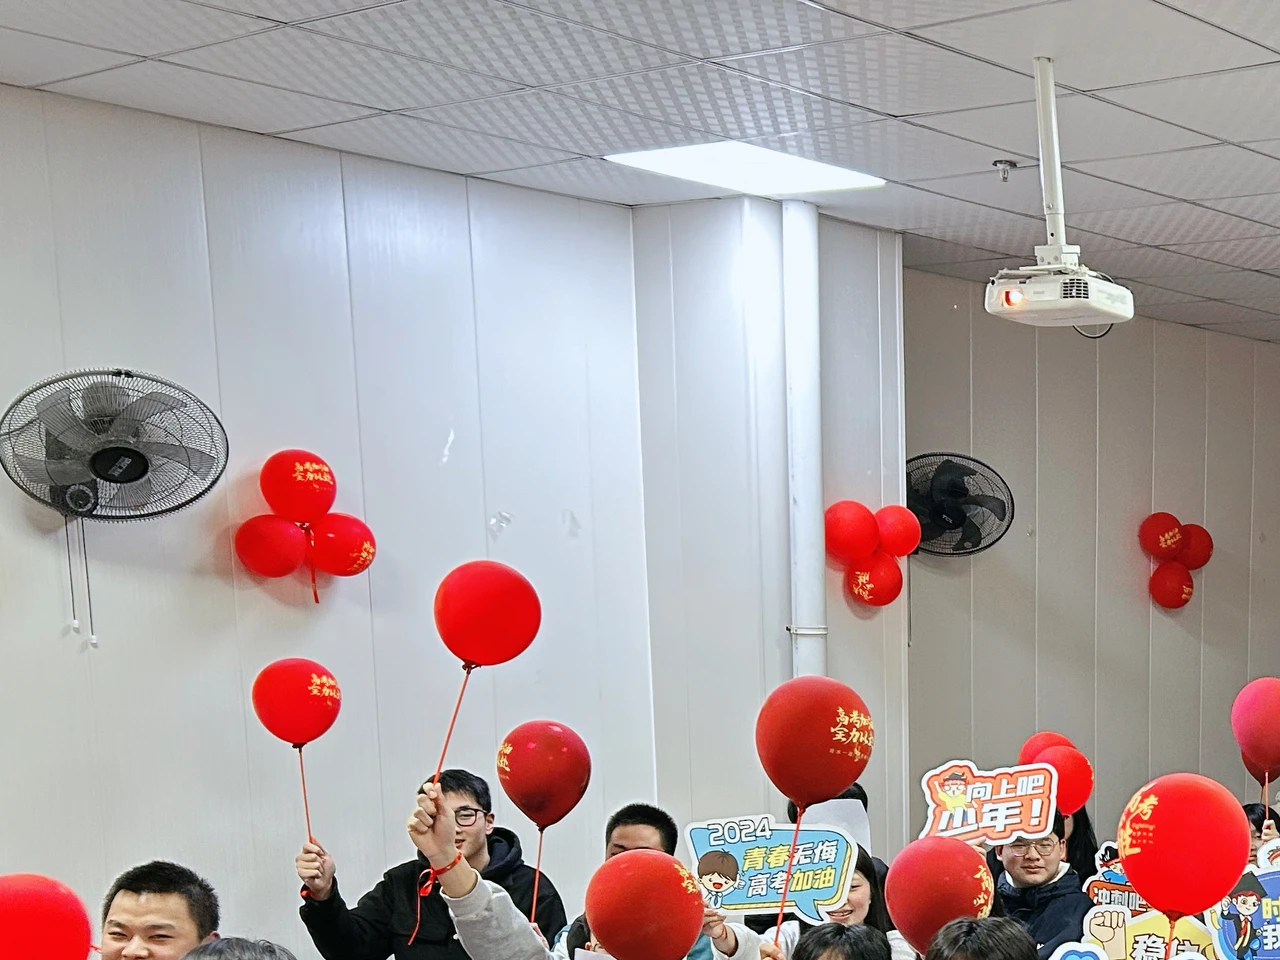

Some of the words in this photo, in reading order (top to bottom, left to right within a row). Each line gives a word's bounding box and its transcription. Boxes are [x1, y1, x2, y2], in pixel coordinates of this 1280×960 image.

[965, 774, 1045, 801] 向上吧
[707, 819, 773, 847] 2024
[742, 840, 839, 872] 青春无悔
[747, 868, 835, 899] 高考加油
